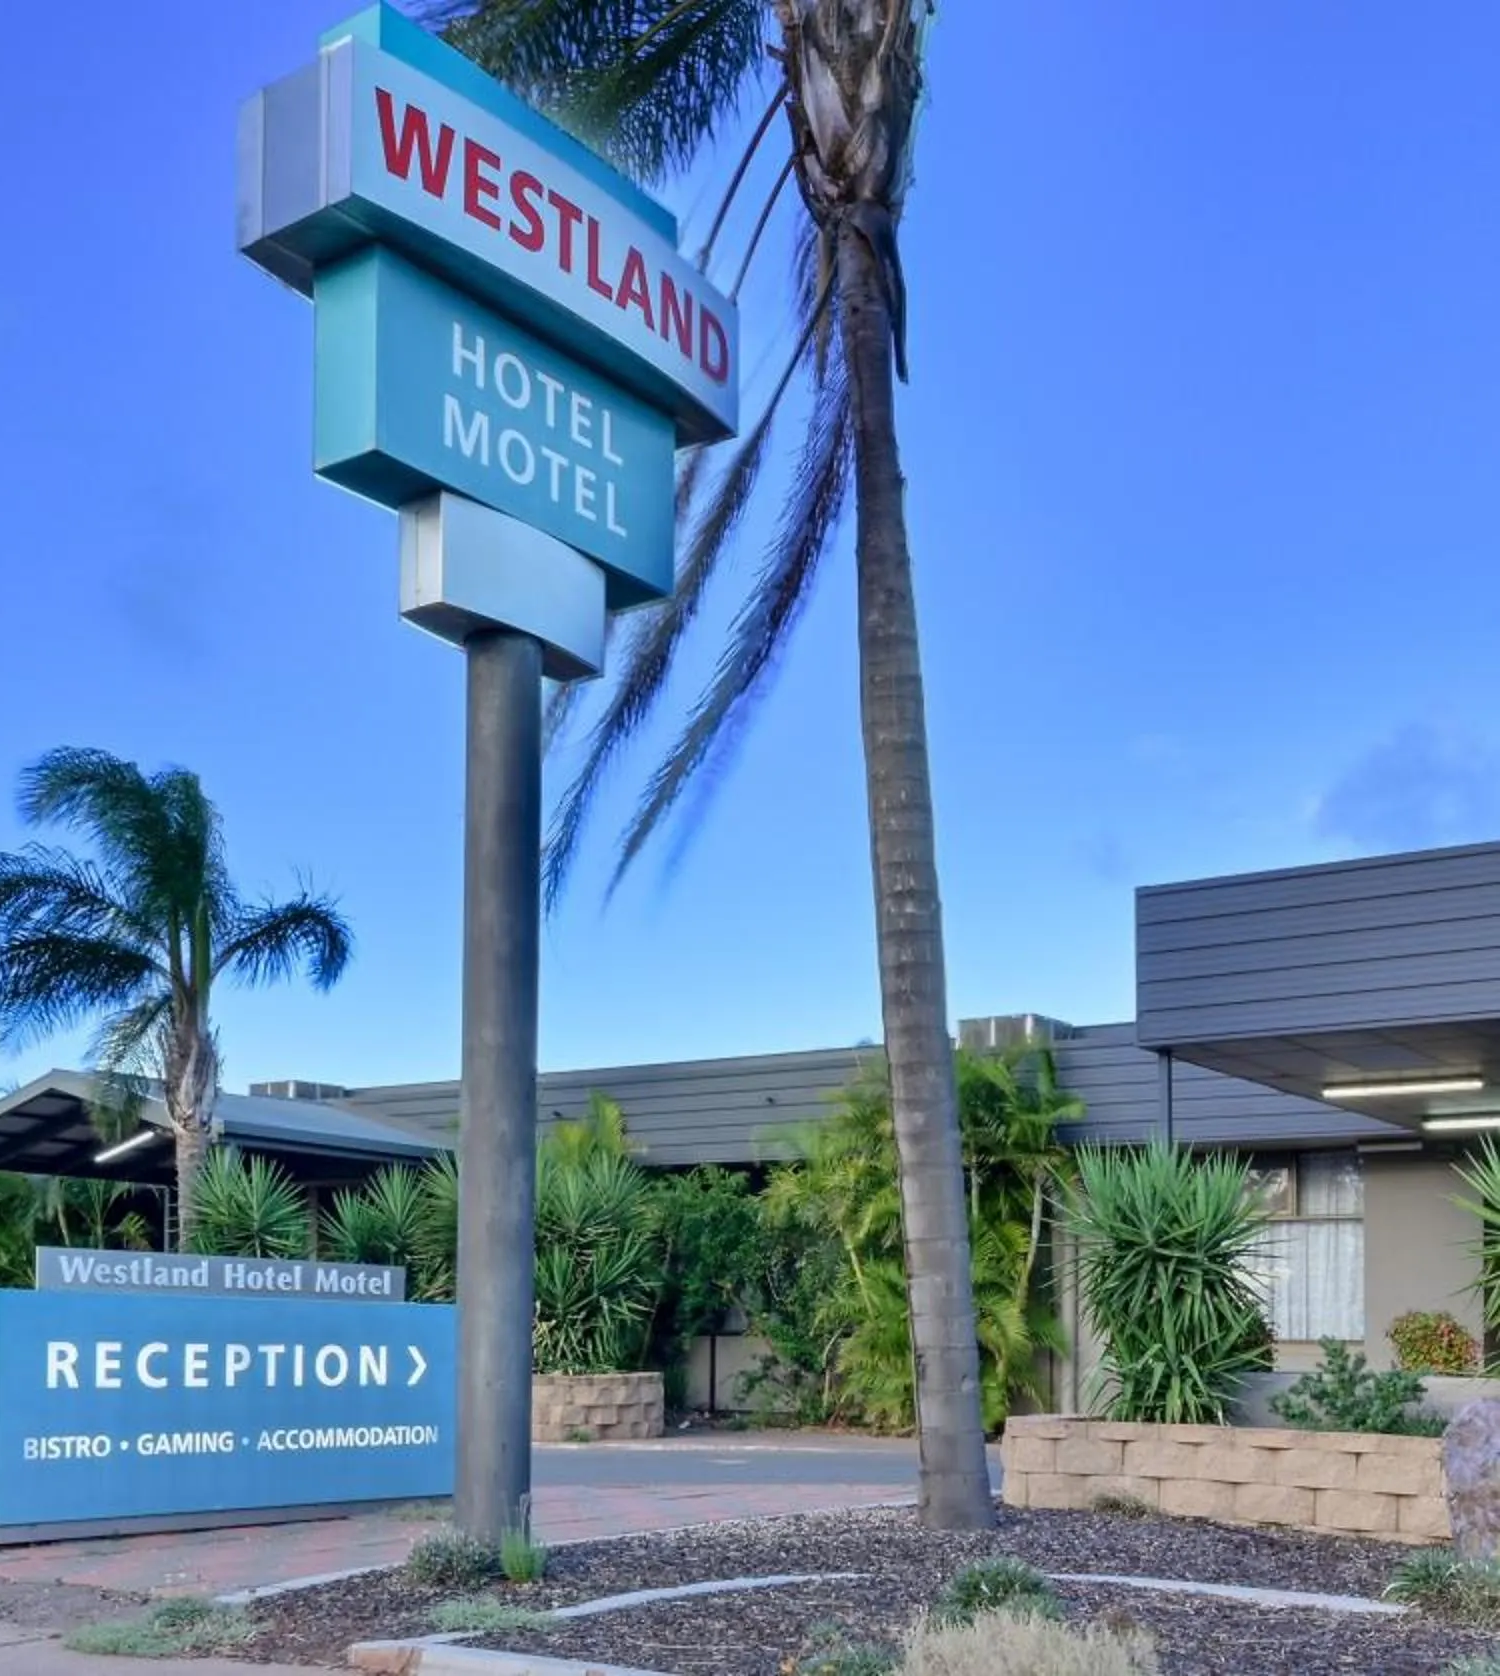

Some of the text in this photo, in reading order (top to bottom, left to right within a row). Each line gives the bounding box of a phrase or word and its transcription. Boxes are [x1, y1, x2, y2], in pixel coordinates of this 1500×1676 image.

[375, 86, 730, 386] WESTLAND
[451, 321, 624, 467] HOTEL
[442, 396, 627, 538] MOTEL
[59, 1255, 392, 1296] Westland Hotel Motel
[46, 1340, 389, 1389] RECEPTION
[23, 1424, 440, 1460] BISTRO GAMING ACCOMMODATION
